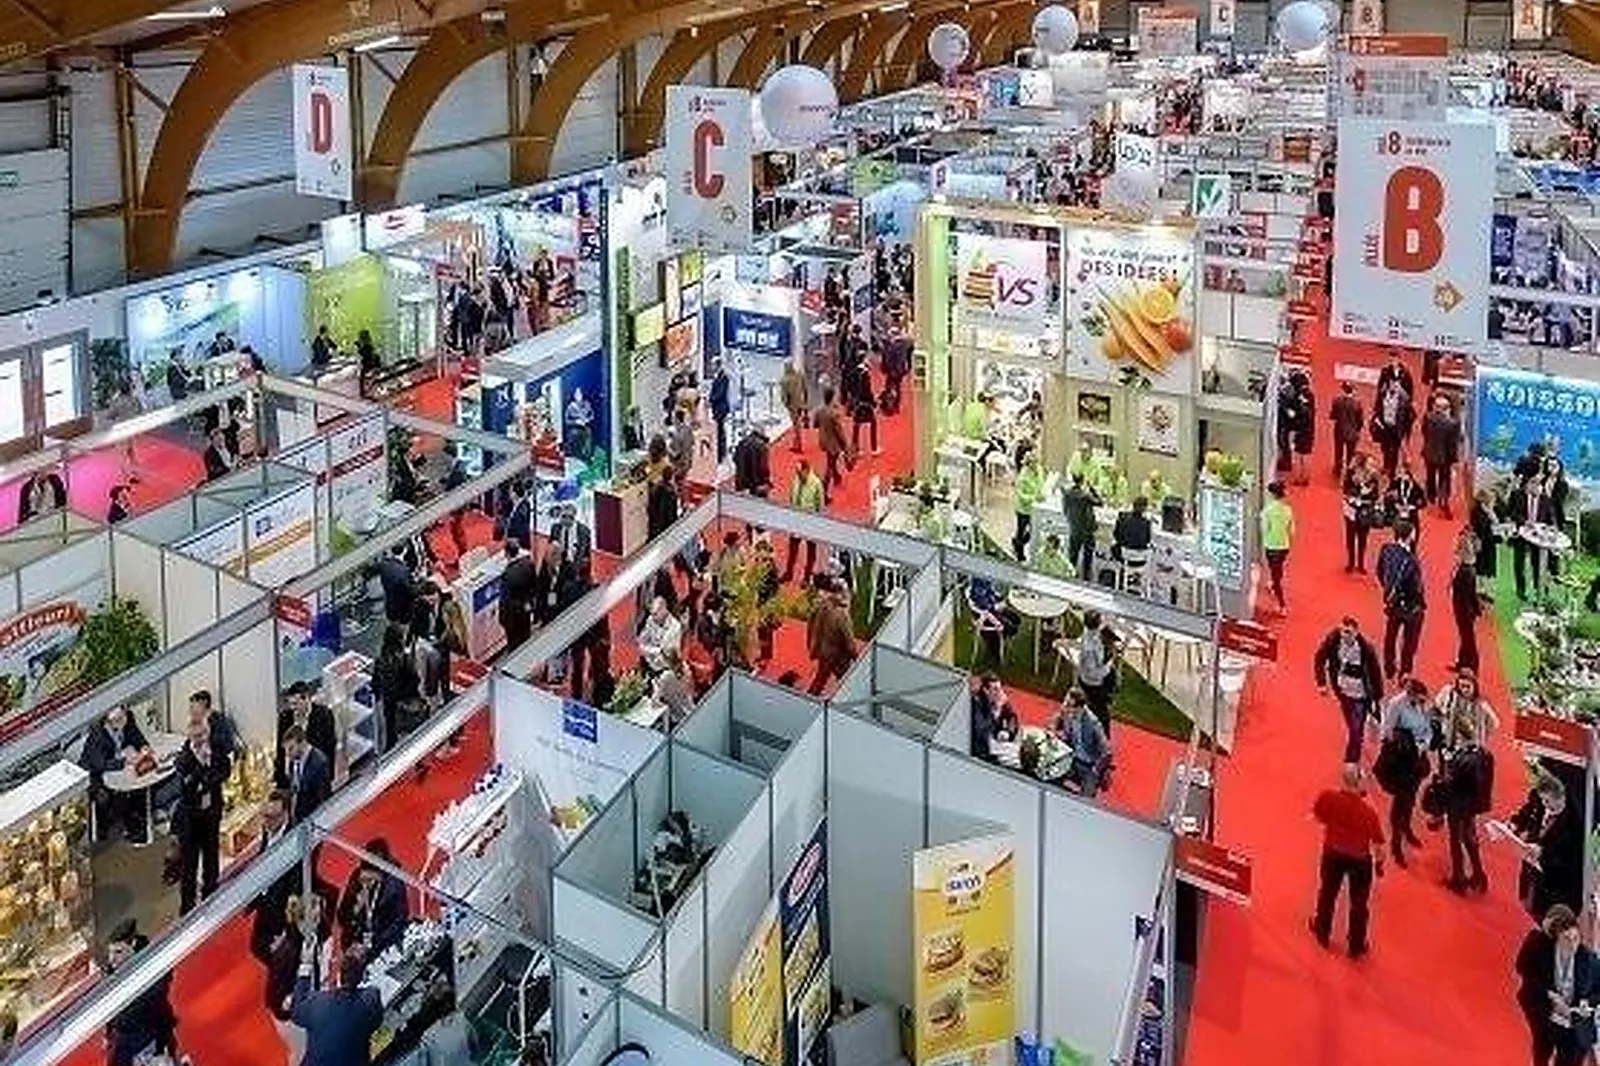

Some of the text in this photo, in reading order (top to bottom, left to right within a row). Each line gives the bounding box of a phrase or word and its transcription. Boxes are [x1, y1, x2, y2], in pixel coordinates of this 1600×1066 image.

[311, 92, 332, 155] D
[1387, 130, 1402, 155] 8
[694, 120, 724, 199] C
[1384, 166, 1444, 272] B
[1486, 382, 1600, 417] SOISSO
